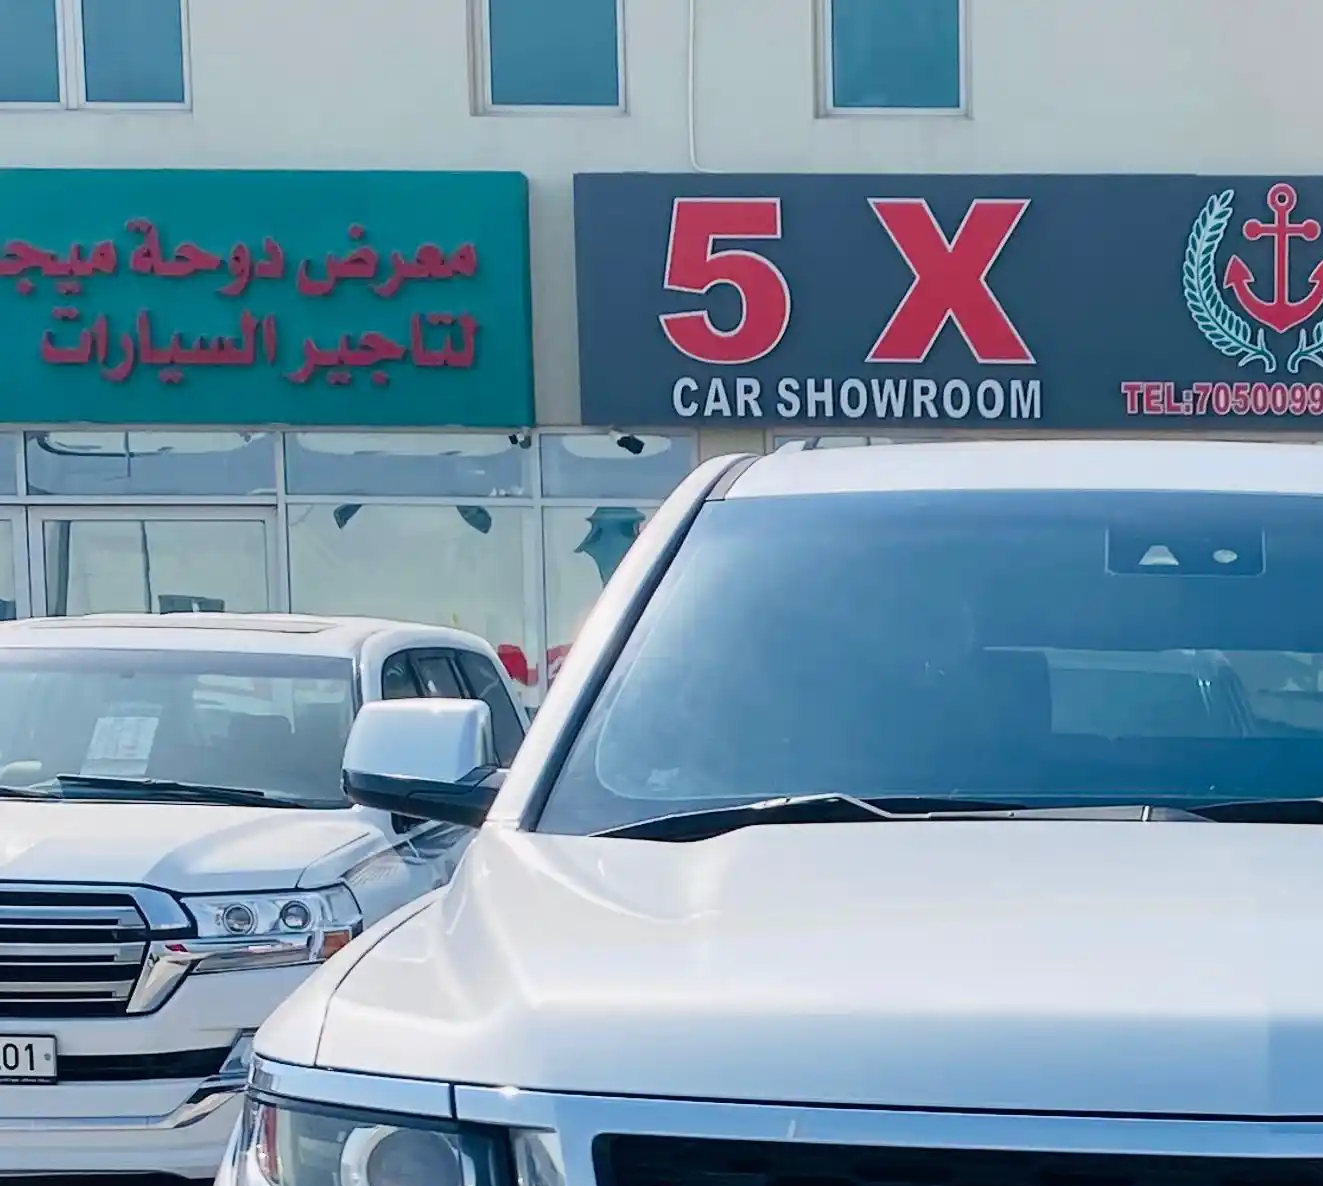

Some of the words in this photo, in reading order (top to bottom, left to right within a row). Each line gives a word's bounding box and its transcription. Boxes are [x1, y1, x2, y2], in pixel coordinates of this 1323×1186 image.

[0, 239, 116, 296] ميج
[125, 217, 284, 296] دوحة
[298, 223, 478, 296] معرض
[658, 197, 791, 365] 5
[864, 197, 1037, 364] X
[41, 308, 276, 382] السيارات
[284, 311, 479, 384] لتاجير
[672, 377, 761, 419] CAR
[776, 377, 1042, 420] SHOWROOM
[0, 1043, 35, 1071] 01
